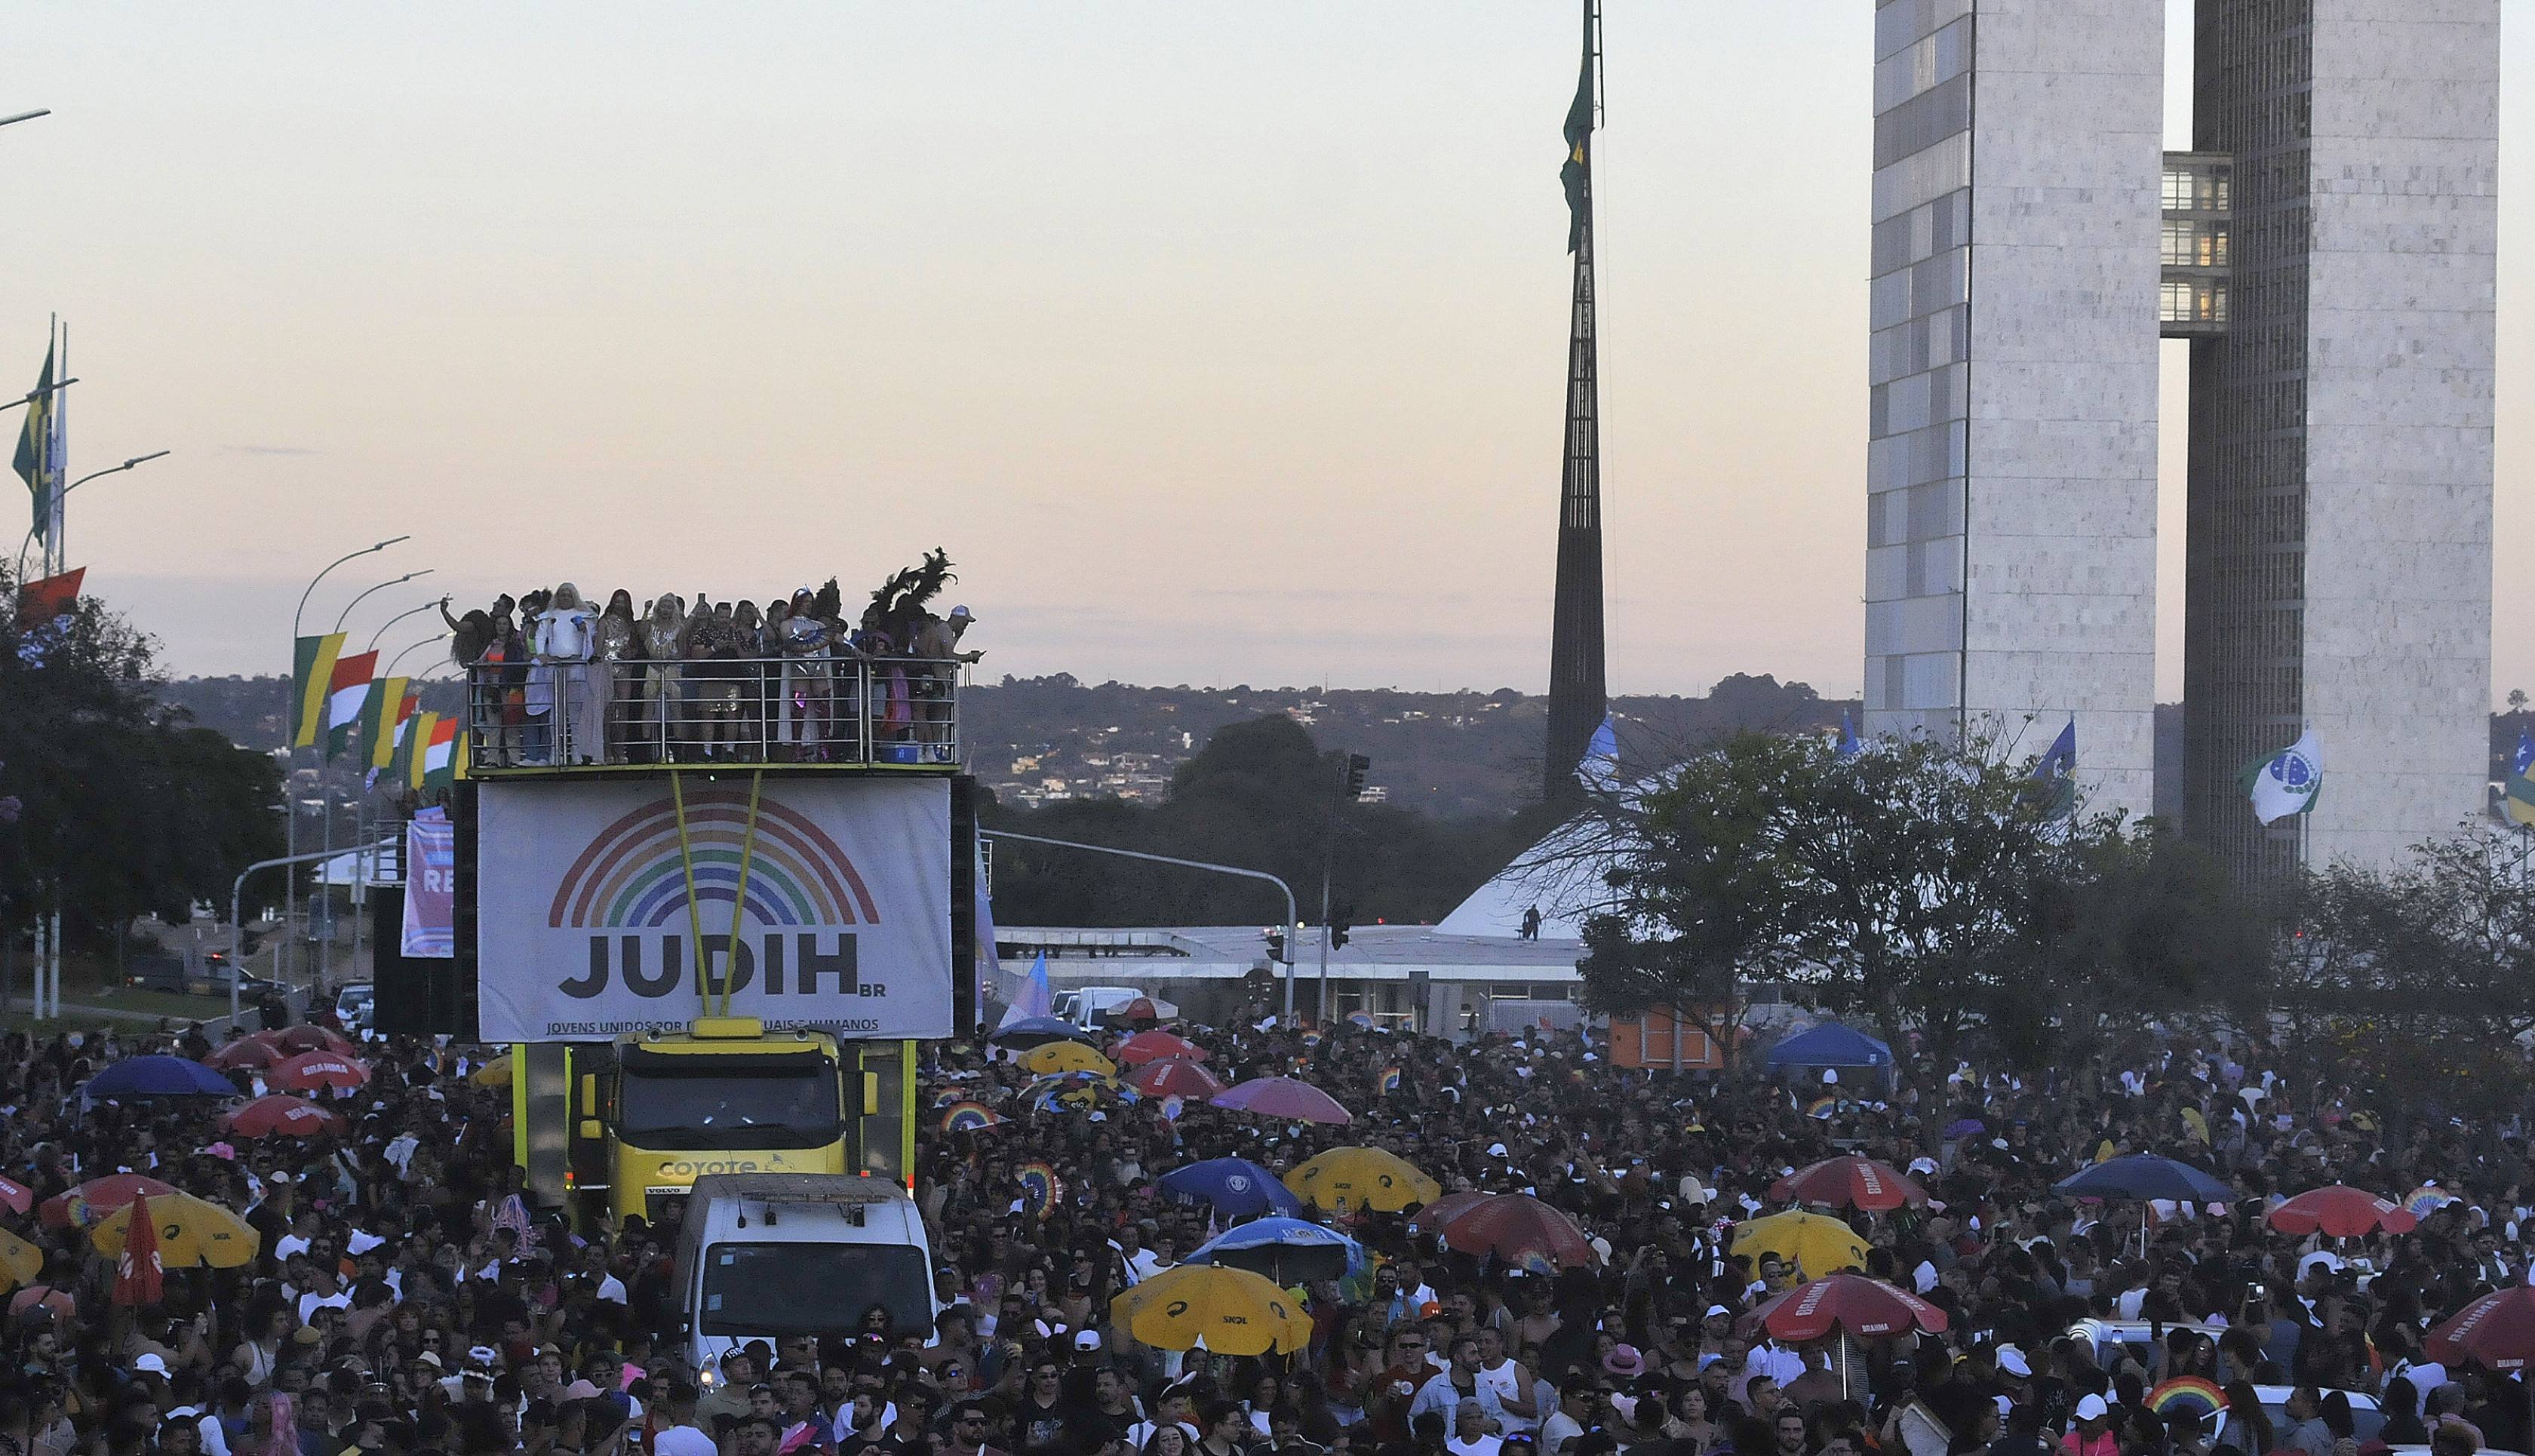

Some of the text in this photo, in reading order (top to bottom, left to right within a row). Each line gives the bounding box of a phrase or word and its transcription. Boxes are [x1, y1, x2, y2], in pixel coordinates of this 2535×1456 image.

[558, 932, 858, 999] JUDIH
[859, 983, 887, 997] BR
[546, 1022, 596, 1036] JOVENS
[599, 1021, 652, 1033] UNIDOS
[303, 1063, 349, 1077] BRAHMA
[1222, 1315, 1248, 1325] SKOL
[2447, 1301, 2501, 1342] BRAHMA
[1861, 1322, 1890, 1333] BRAHMA
